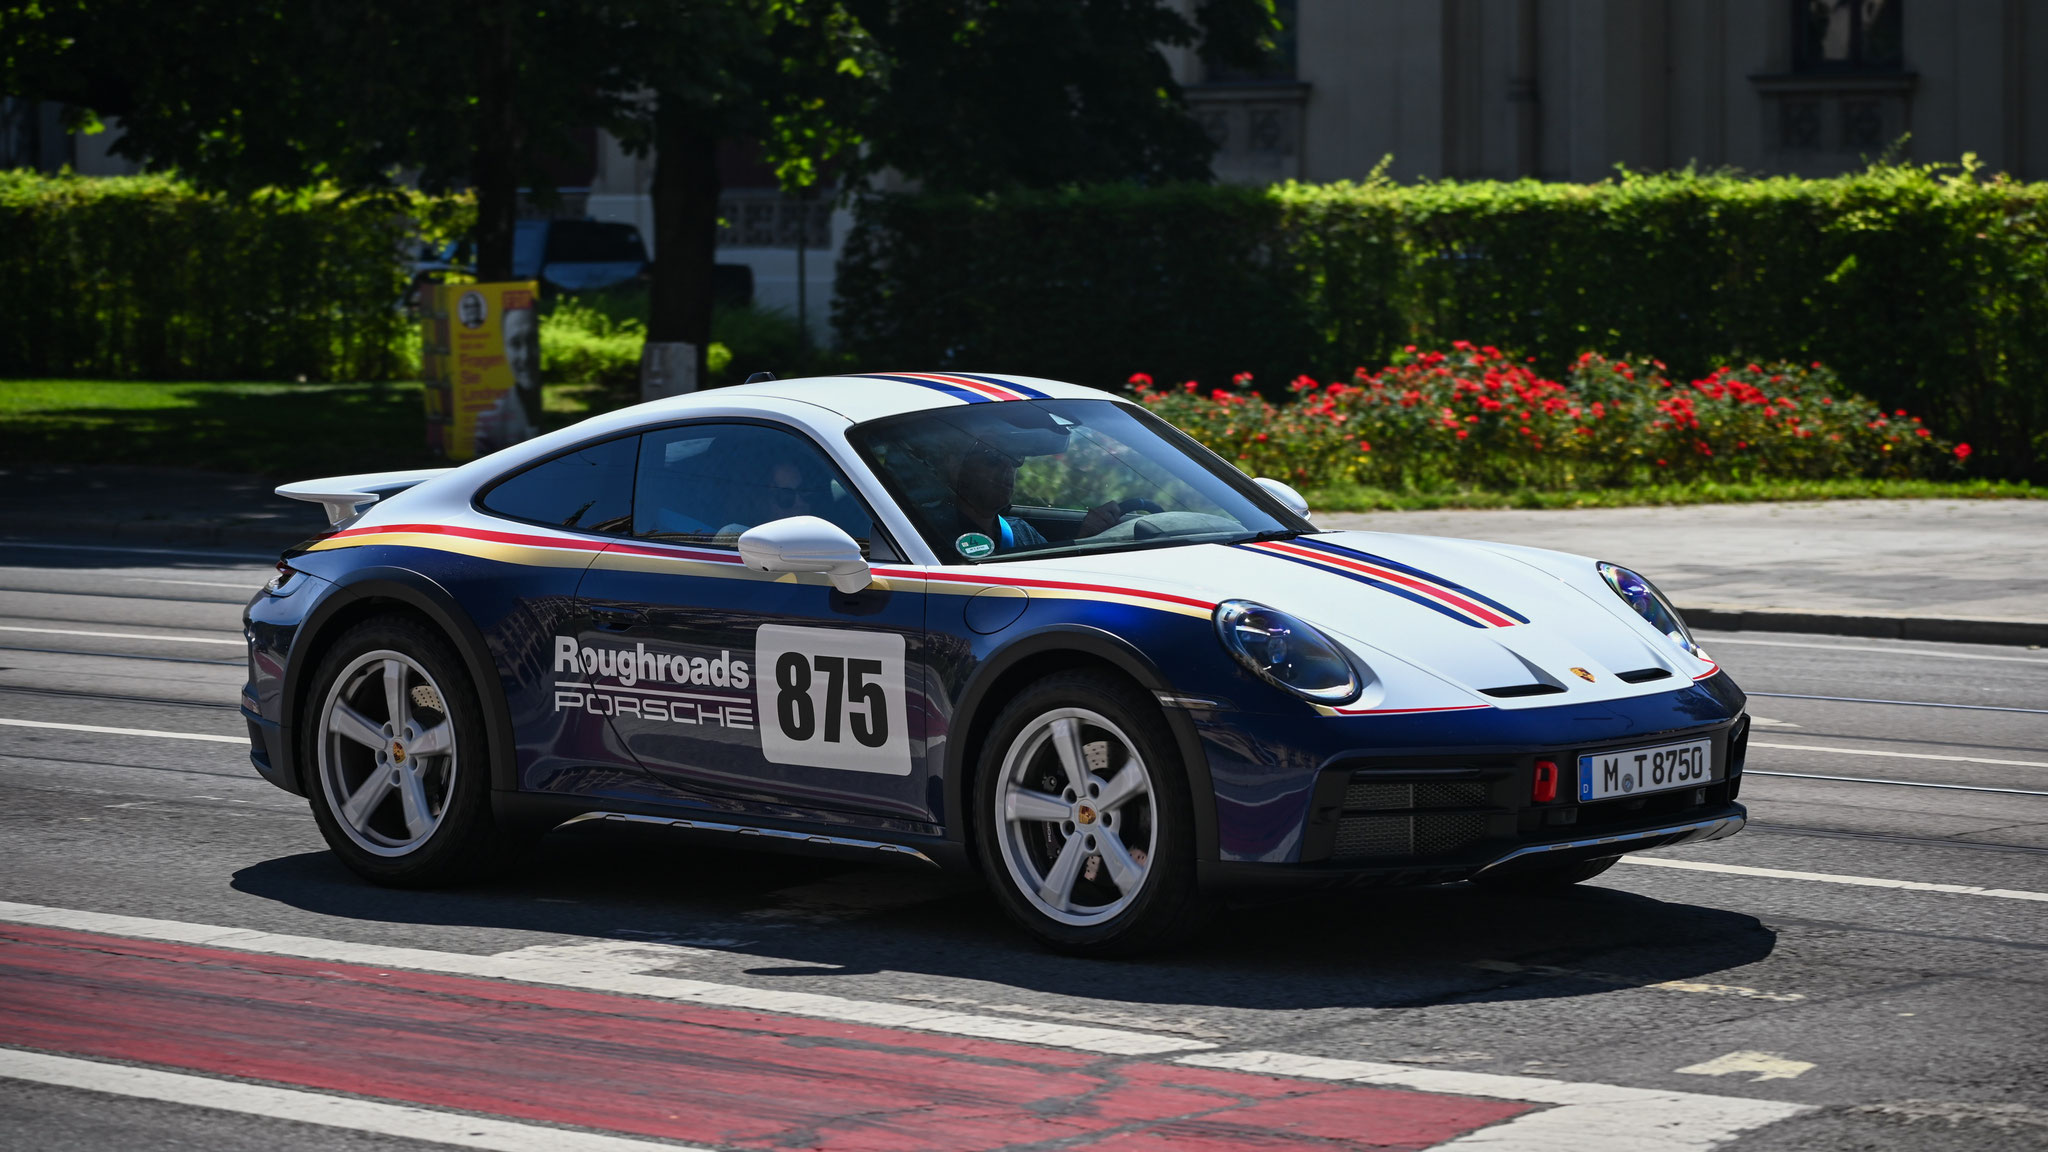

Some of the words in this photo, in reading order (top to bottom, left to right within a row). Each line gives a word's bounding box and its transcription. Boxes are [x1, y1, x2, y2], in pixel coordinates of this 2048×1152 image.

[969, 536, 978, 545] 4
[554, 635, 750, 690] Roughroads
[554, 691, 754, 730] PORSCHE
[775, 651, 889, 748] 875
[1583, 783, 1589, 794] D
[1604, 757, 1619, 793] M
[1634, 754, 1648, 788] T
[1652, 746, 1703, 785] 8750
